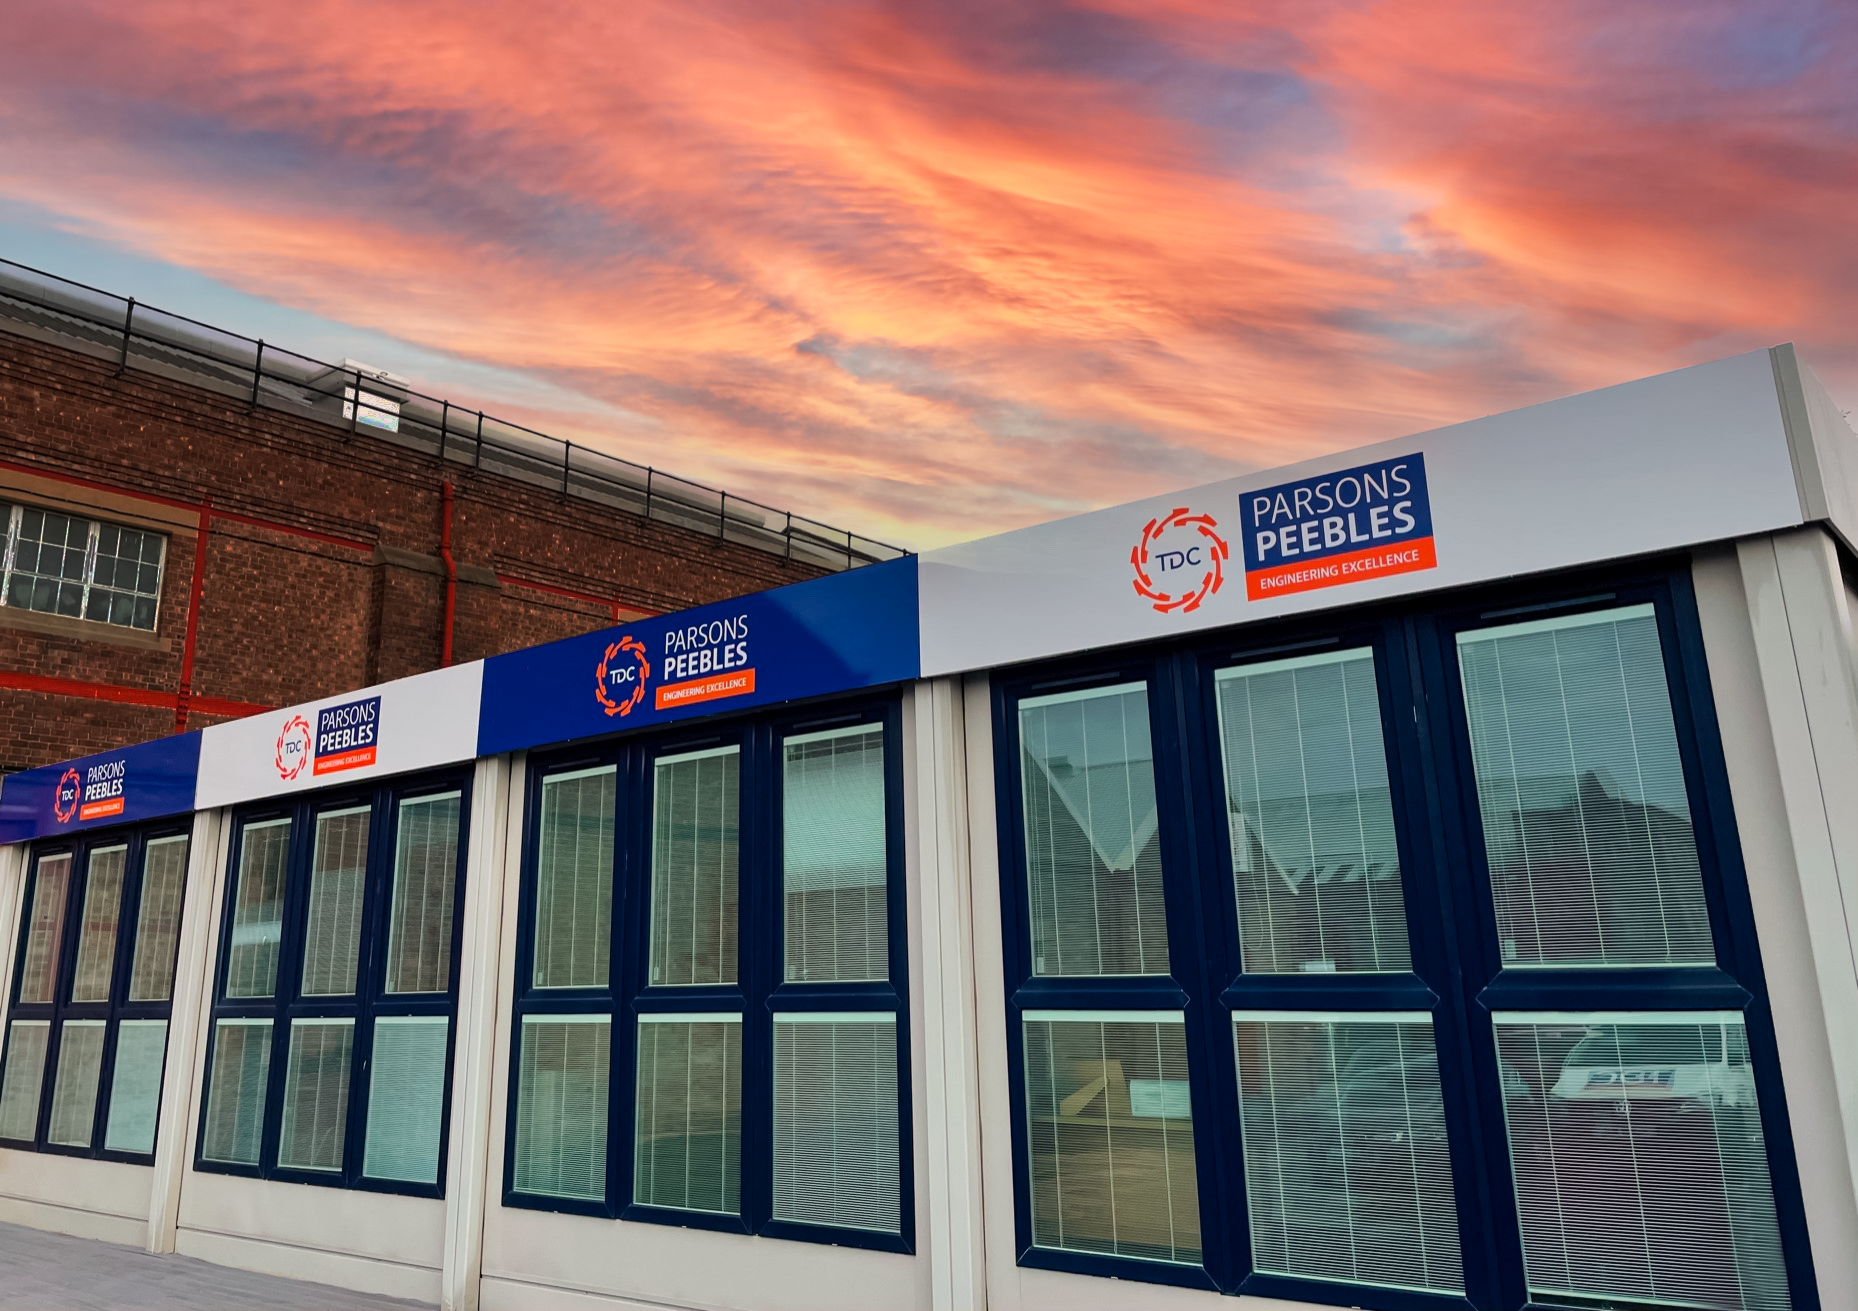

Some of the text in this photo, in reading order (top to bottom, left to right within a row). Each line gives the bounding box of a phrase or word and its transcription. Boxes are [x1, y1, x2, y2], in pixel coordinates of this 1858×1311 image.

[1253, 464, 1412, 528] PARSONS
[1256, 500, 1416, 562] PEEBLES
[1155, 546, 1202, 572] TDC
[1259, 549, 1420, 590] ENGINEERING EXCELLENCE
[664, 614, 749, 655] PARSONS
[609, 665, 636, 685] TDC
[663, 641, 748, 681] PEEBLES
[663, 677, 747, 701] ENGINEERING EXCELLENCE
[321, 701, 376, 732] PARSONS
[285, 740, 302, 754] TDC
[319, 723, 374, 753] PEEBLES
[87, 760, 126, 783] PARSONS
[85, 779, 123, 801] PEEBLES
